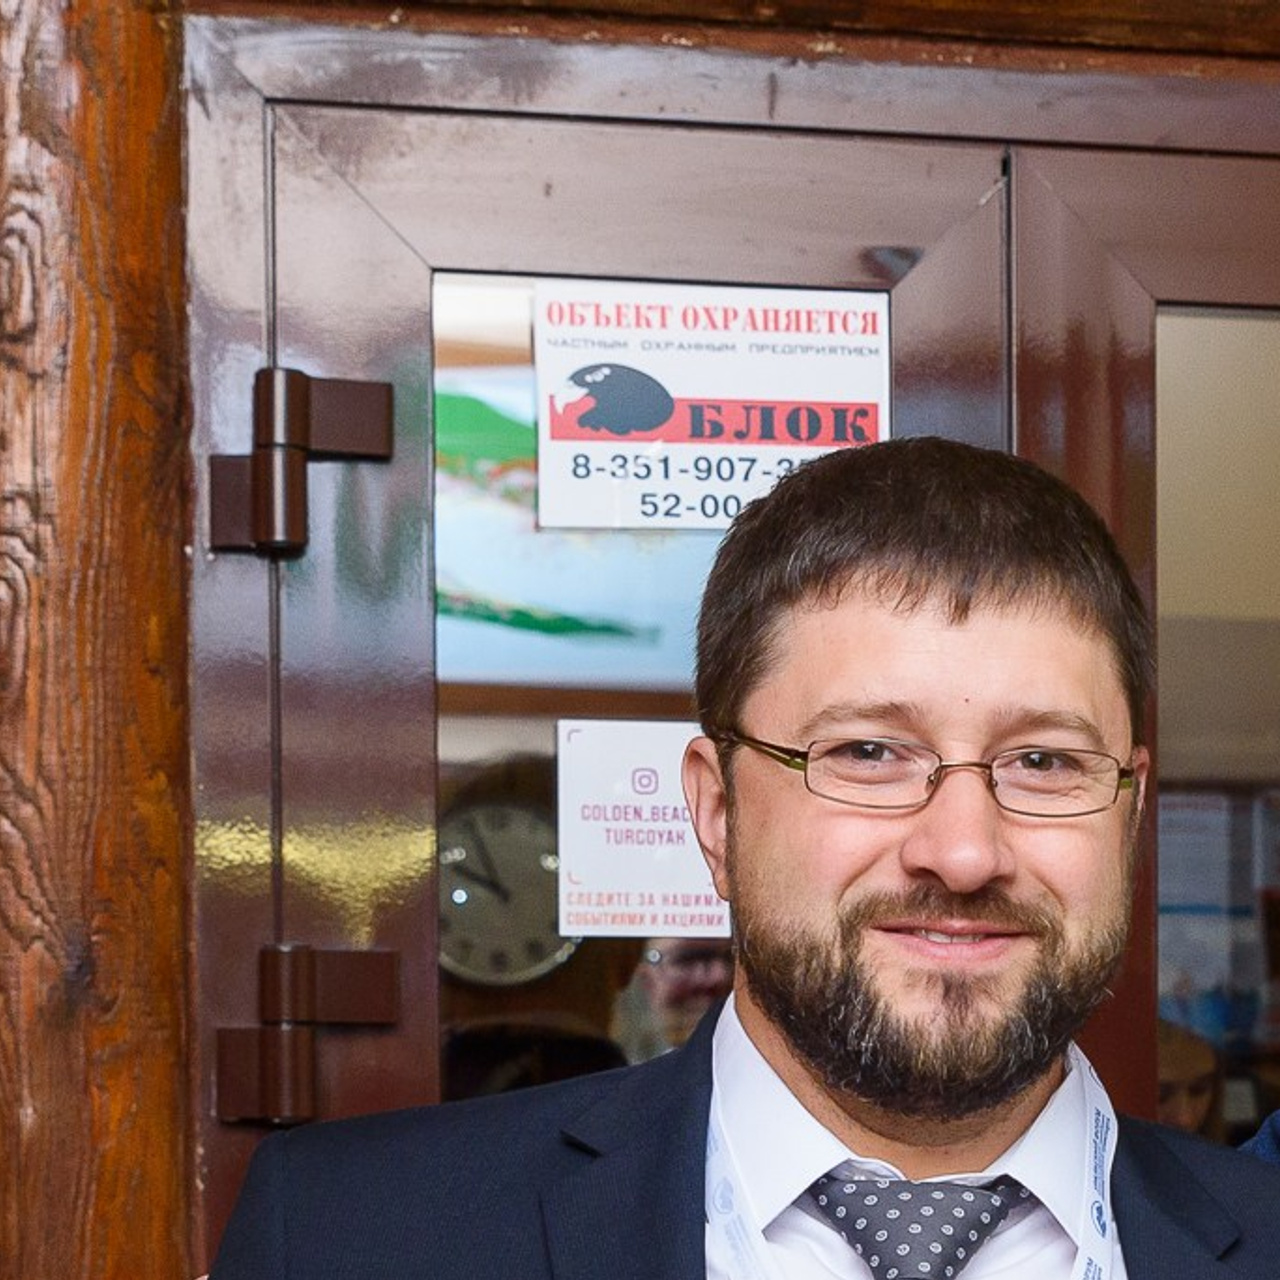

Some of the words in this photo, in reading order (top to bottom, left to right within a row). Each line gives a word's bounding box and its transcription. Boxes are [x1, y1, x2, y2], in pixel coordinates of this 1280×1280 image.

[547, 301, 673, 330] ОБЪЕКТ
[681, 306, 879, 336] ОХРАНЯЕТСЯ
[547, 337, 628, 350] ЧАСТНЫМ
[640, 340, 737, 352] ОХРАННЫМ
[749, 343, 880, 357] ПРЕДПРИЯТИЕМ
[687, 404, 871, 442] БЛОК
[567, 892, 630, 907] СЛЕДИТЕ
[639, 892, 655, 906] ЗА
[566, 913, 645, 927] СОБЫТИЯМИ
[651, 914, 659, 926] И
[664, 914, 725, 928] АКЦИЯМИ
